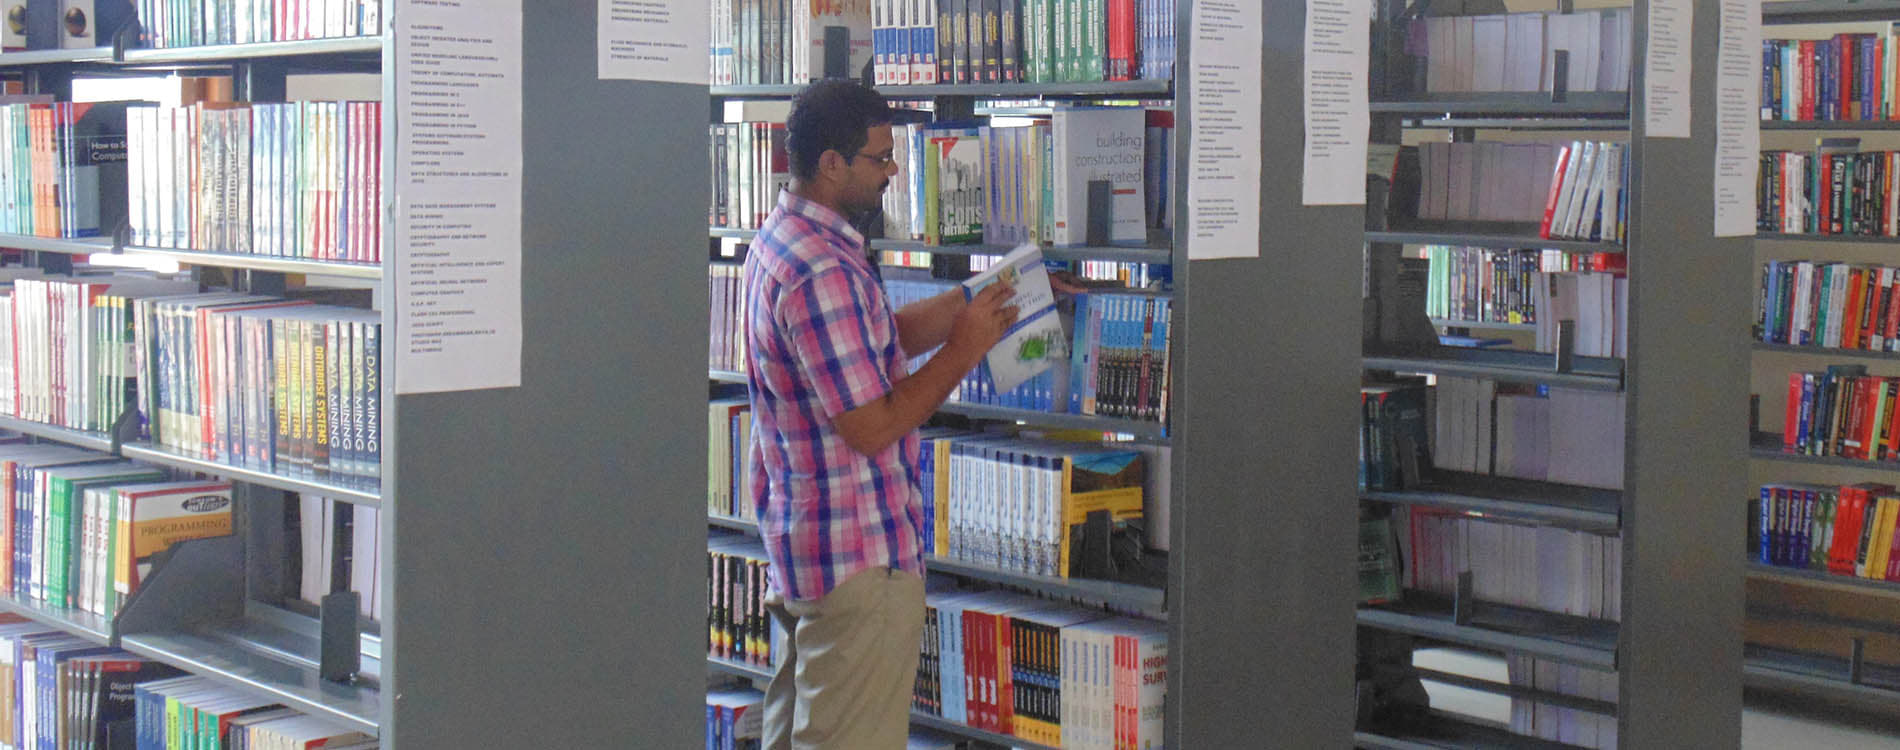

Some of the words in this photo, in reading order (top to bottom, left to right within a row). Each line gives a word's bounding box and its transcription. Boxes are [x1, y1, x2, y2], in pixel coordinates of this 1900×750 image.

[314, 346, 326, 398] DATABASE
[366, 356, 376, 392] DATA
[316, 399, 327, 446] SYSTEMS
[330, 394, 340, 449] MINING
[343, 396, 352, 451] MINING
[355, 396, 364, 452] MINING
[368, 398, 377, 454] MINING
